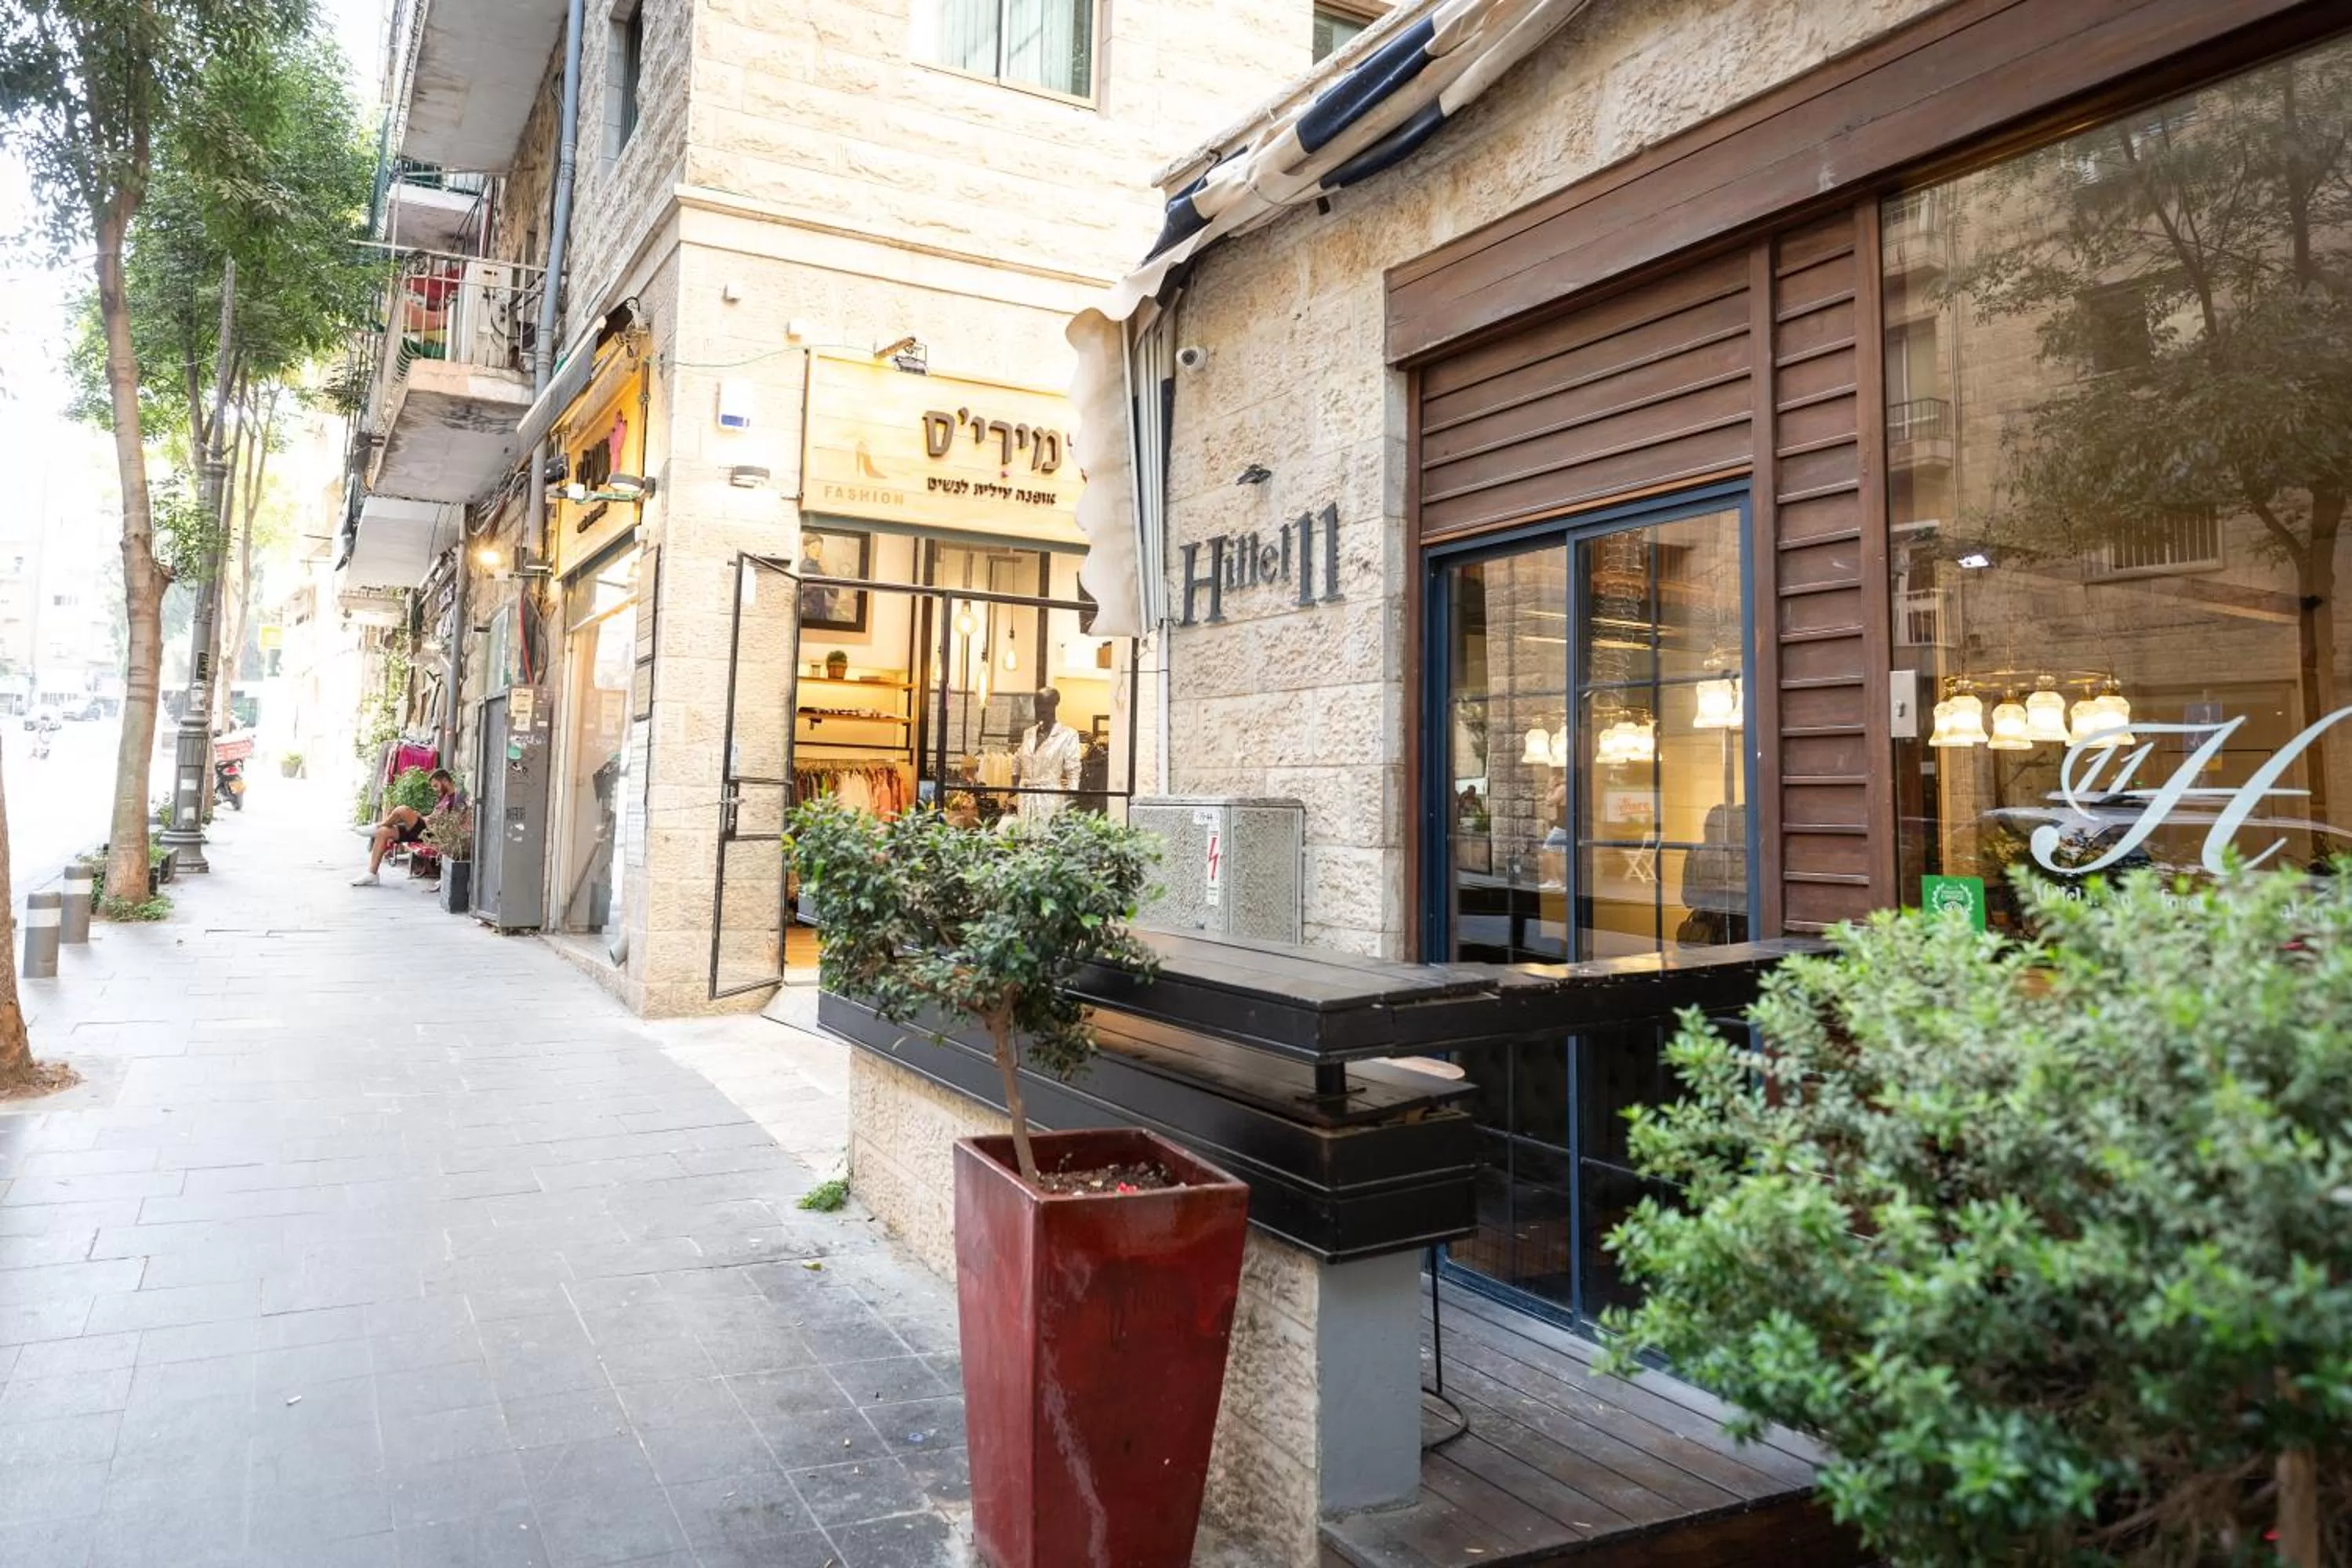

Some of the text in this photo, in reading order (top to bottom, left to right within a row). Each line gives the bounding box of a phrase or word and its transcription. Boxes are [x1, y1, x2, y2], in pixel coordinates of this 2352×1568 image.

[927, 476, 969, 495] לנשים
[824, 485, 904, 506] FASHION
[1015, 488, 1057, 505] אופנה
